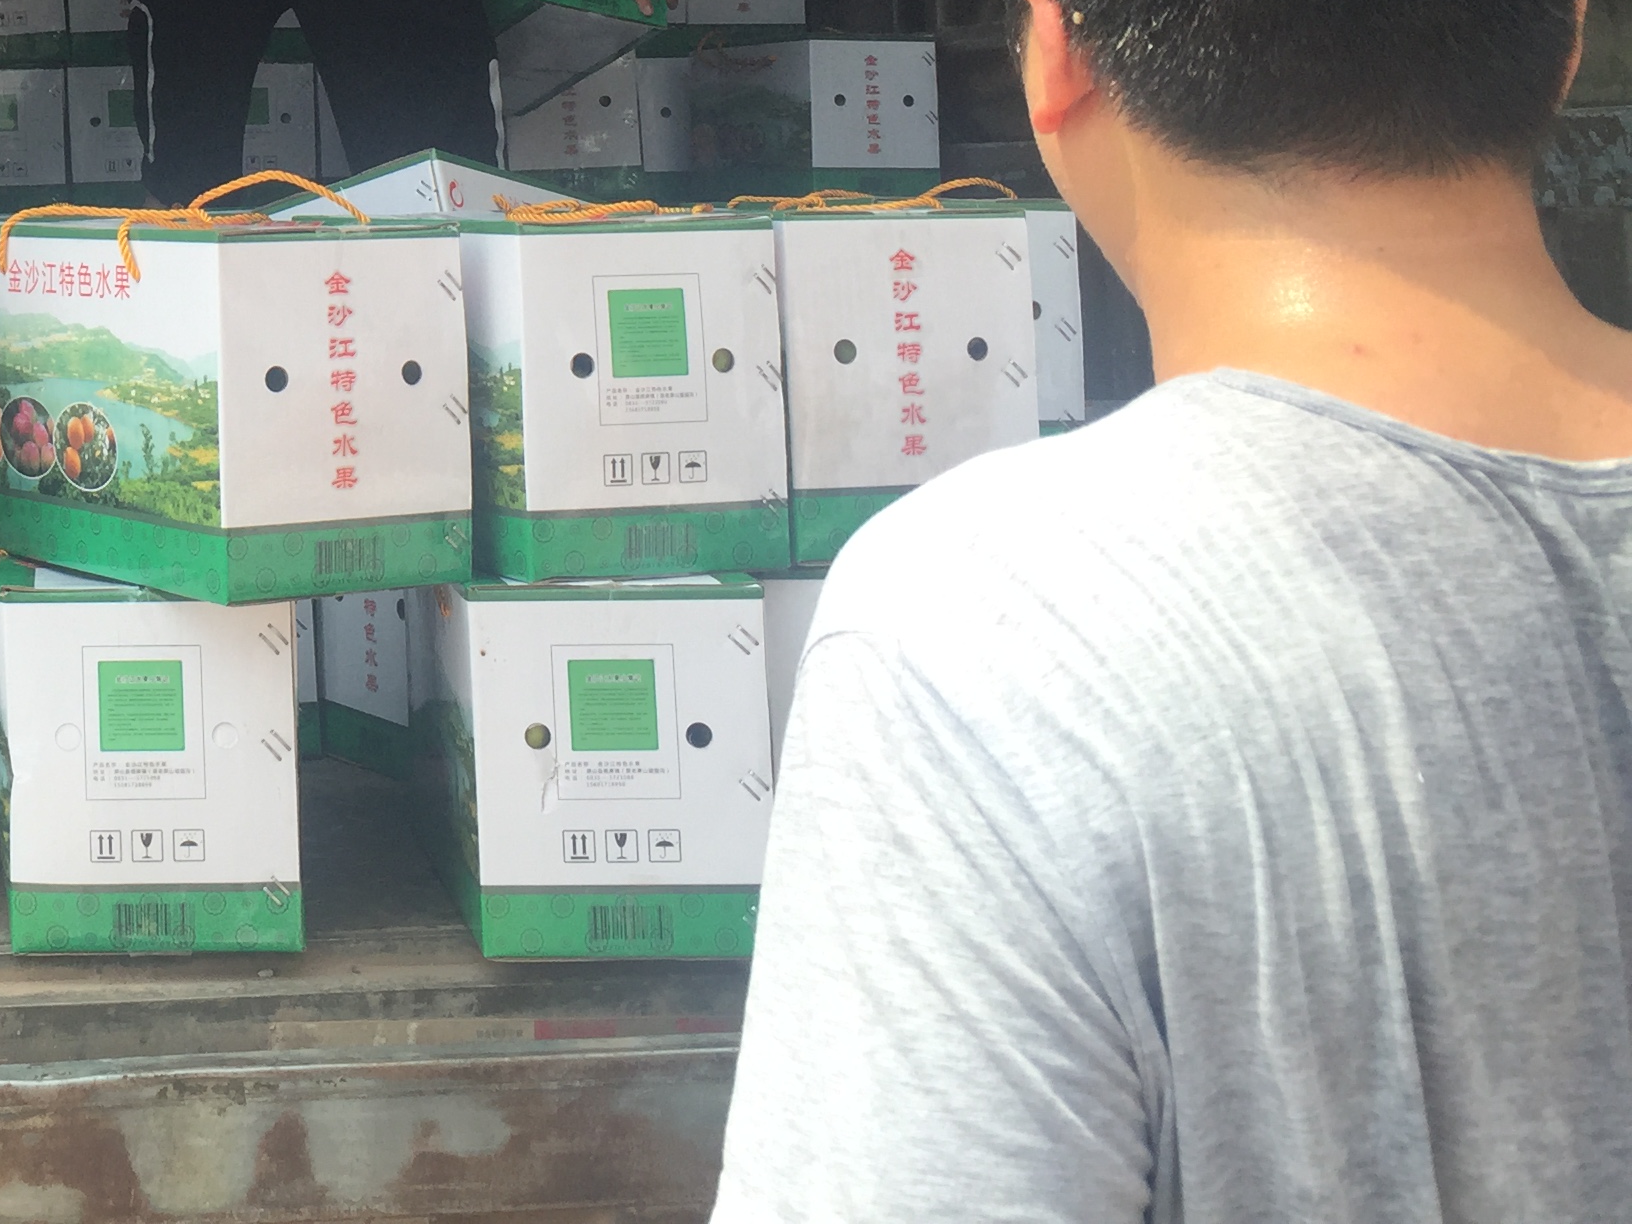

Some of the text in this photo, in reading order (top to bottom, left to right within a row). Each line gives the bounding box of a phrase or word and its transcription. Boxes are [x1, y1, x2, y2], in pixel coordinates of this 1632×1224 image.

[8, 259, 132, 301] 金沙江特色水果
[324, 270, 359, 491] 金沙江特色水果
[888, 248, 928, 458] 金沙江特色水果
